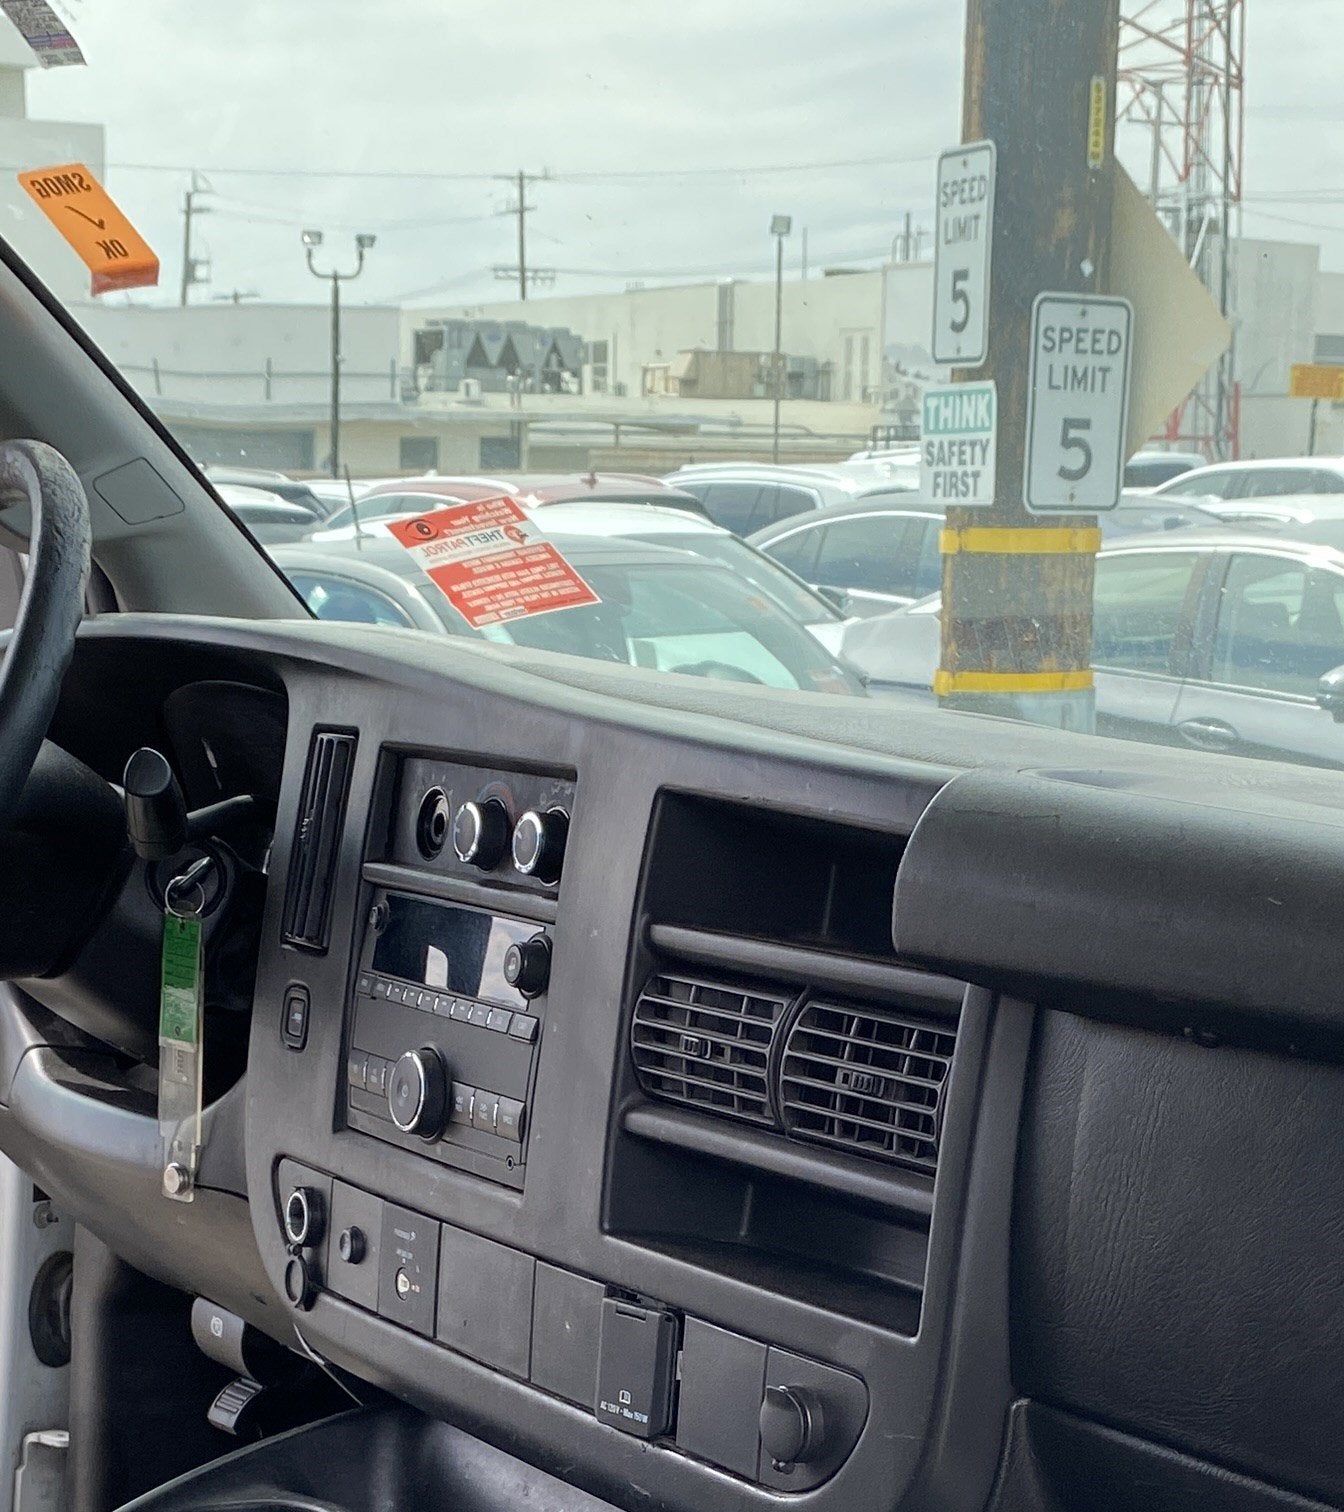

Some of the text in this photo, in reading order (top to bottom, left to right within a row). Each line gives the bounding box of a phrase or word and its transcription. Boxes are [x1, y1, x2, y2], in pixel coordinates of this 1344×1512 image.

[941, 174, 987, 208] SPEED
[944, 214, 981, 245] LIMIT
[950, 268, 970, 334] 5
[1042, 325, 1122, 355] SPEED
[1048, 364, 1110, 393] LIMIT
[926, 393, 990, 430] THINK
[925, 439, 990, 467] SAFETY
[1057, 416, 1093, 482] 5
[932, 470, 981, 498] FIRST
